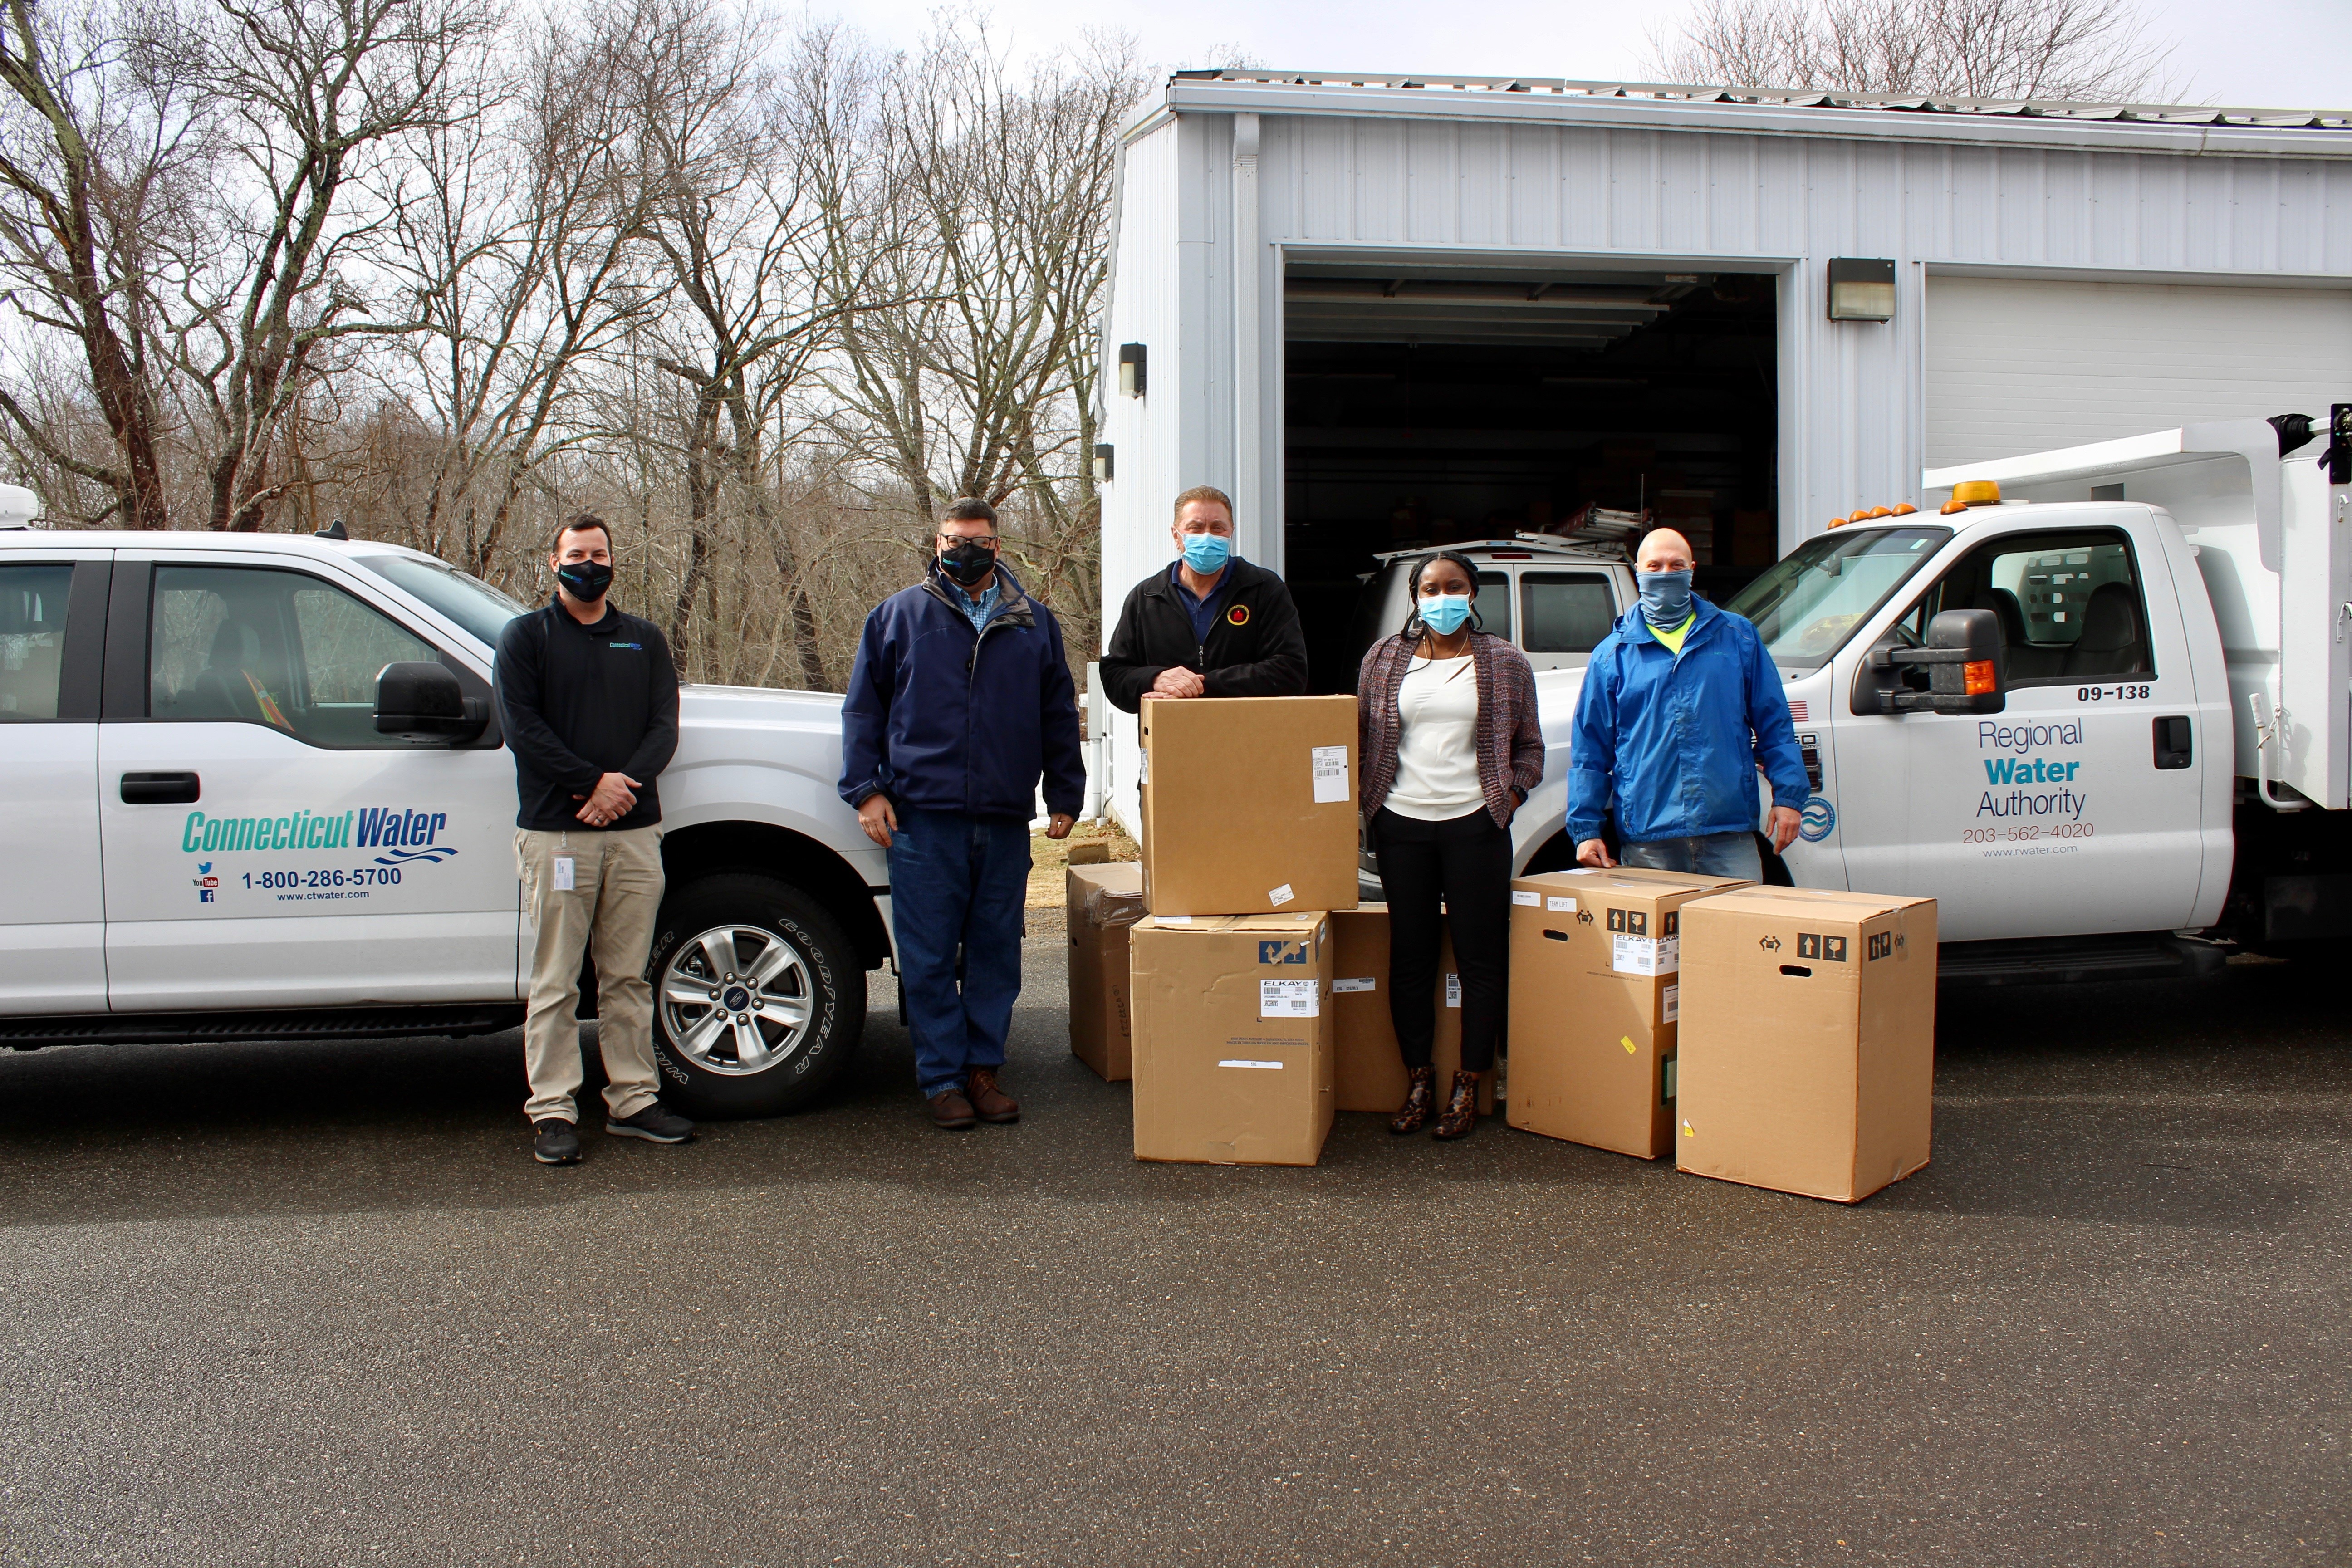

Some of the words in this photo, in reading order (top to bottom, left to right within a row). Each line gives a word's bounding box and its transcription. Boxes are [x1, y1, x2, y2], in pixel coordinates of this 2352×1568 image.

[2077, 686, 2150, 701] 09-138
[1978, 718, 2082, 754] Regional
[1984, 758, 2079, 785] Water
[1976, 787, 2086, 820] Authority
[182, 809, 354, 853] Connecticut
[356, 807, 447, 848] Water
[1963, 823, 2094, 844] 203-562-4020
[1982, 844, 2078, 857] www.rwater.com
[242, 868, 402, 889] 1-800-286-5700
[277, 890, 369, 901] www.ctwater.com
[779, 919, 835, 1074] GOODYEAR
